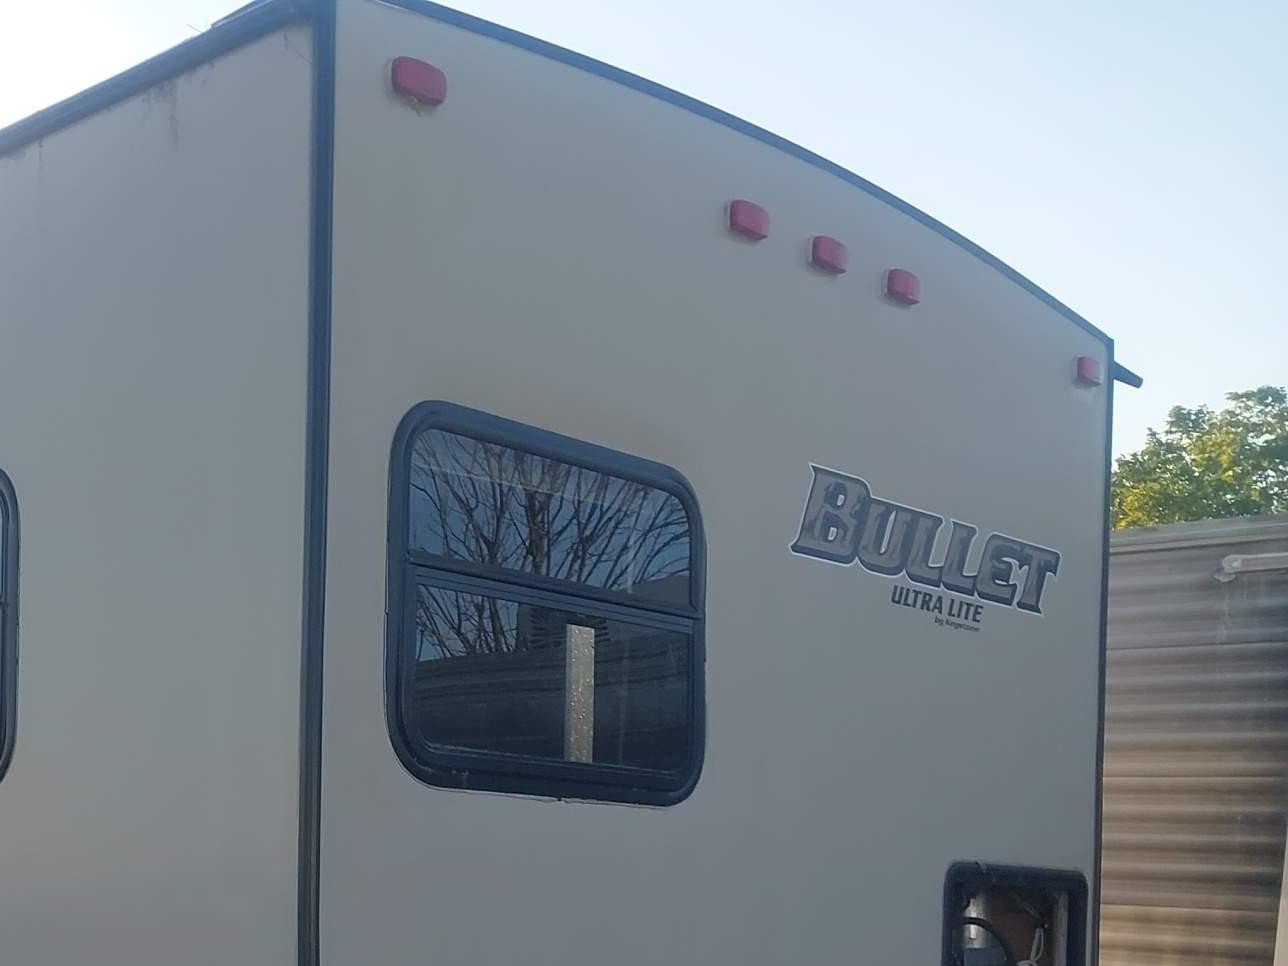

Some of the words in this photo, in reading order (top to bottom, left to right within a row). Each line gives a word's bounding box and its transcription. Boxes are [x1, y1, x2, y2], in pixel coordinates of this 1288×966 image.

[789, 462, 1062, 615] BULLET
[891, 585, 943, 614] ULTRA
[948, 599, 984, 623] LITE
